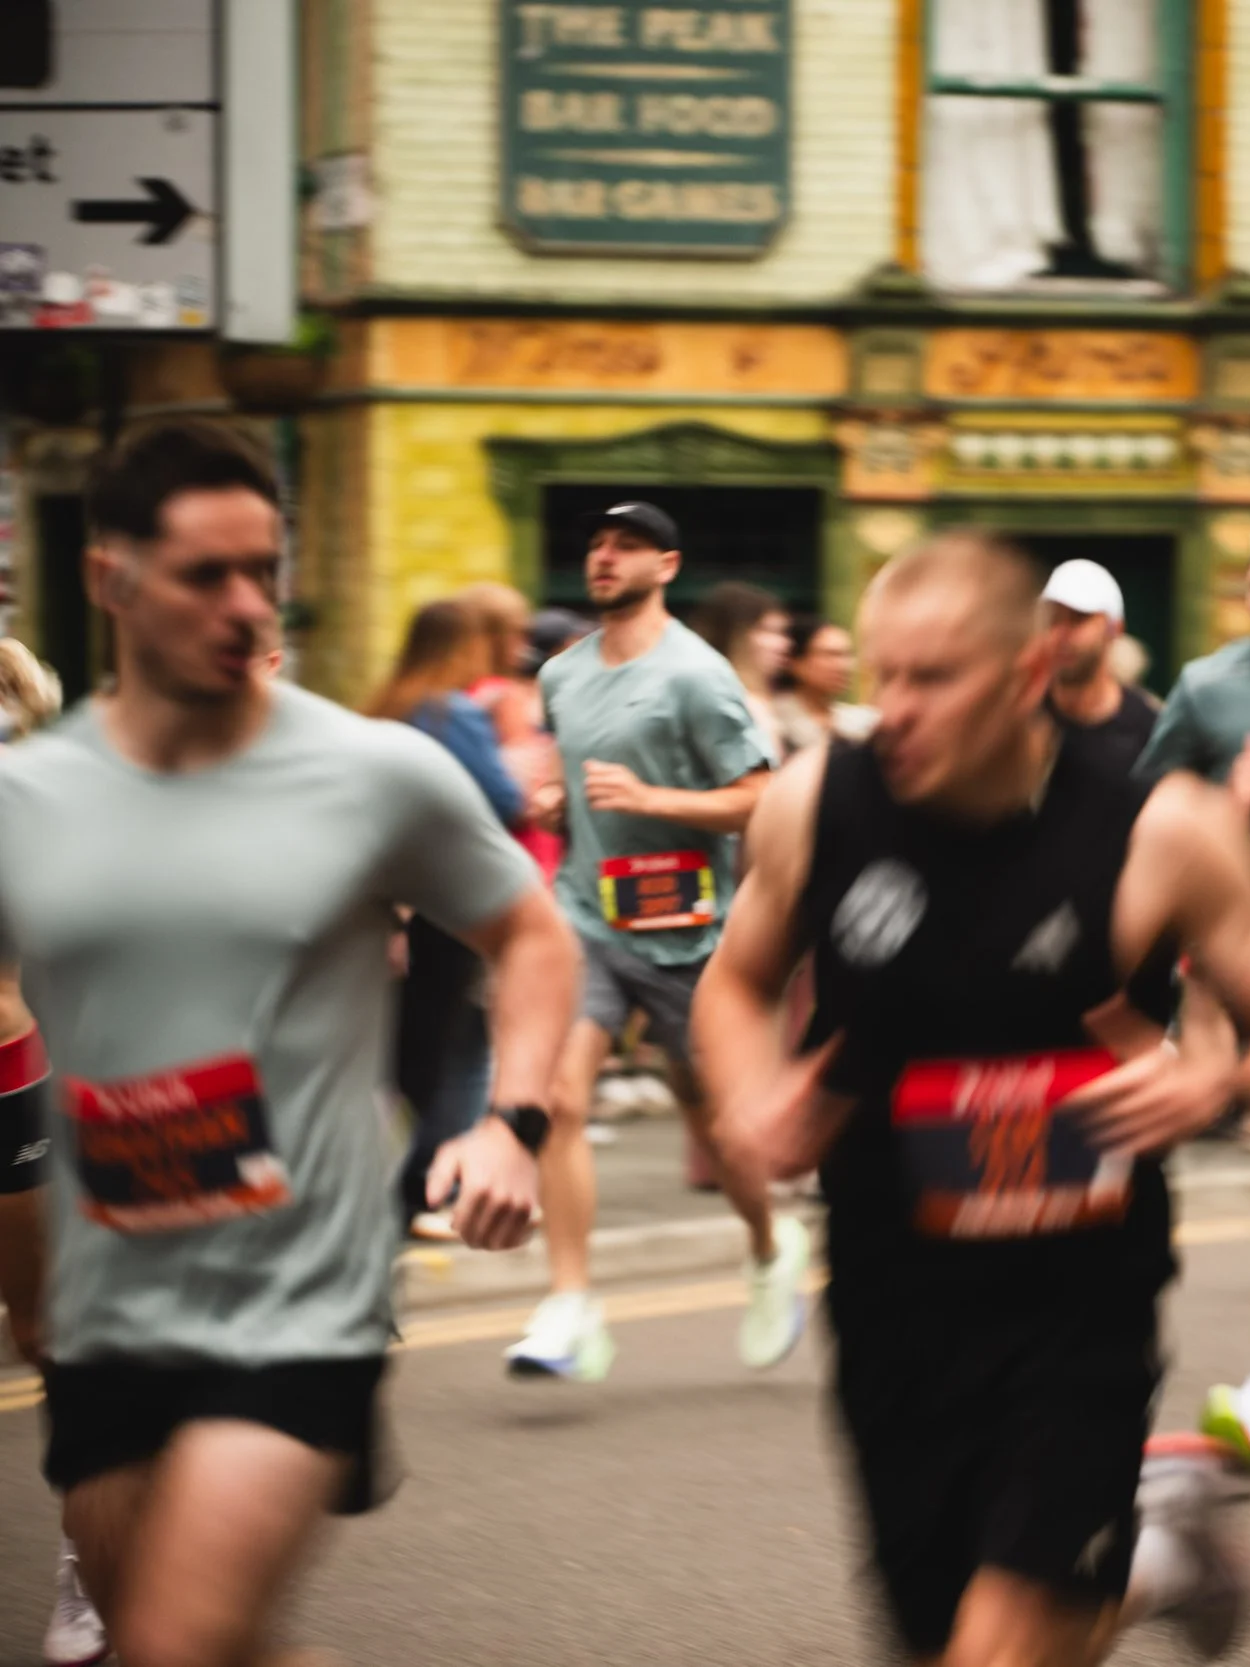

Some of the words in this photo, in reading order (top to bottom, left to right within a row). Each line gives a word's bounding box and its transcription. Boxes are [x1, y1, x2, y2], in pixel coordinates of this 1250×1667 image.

[516, 6, 625, 49] THE
[641, 8, 780, 54] PEAK
[521, 89, 626, 134] BAR
[637, 93, 778, 139] FOOD
[517, 175, 606, 219] BAR
[616, 178, 780, 224] GAMES
